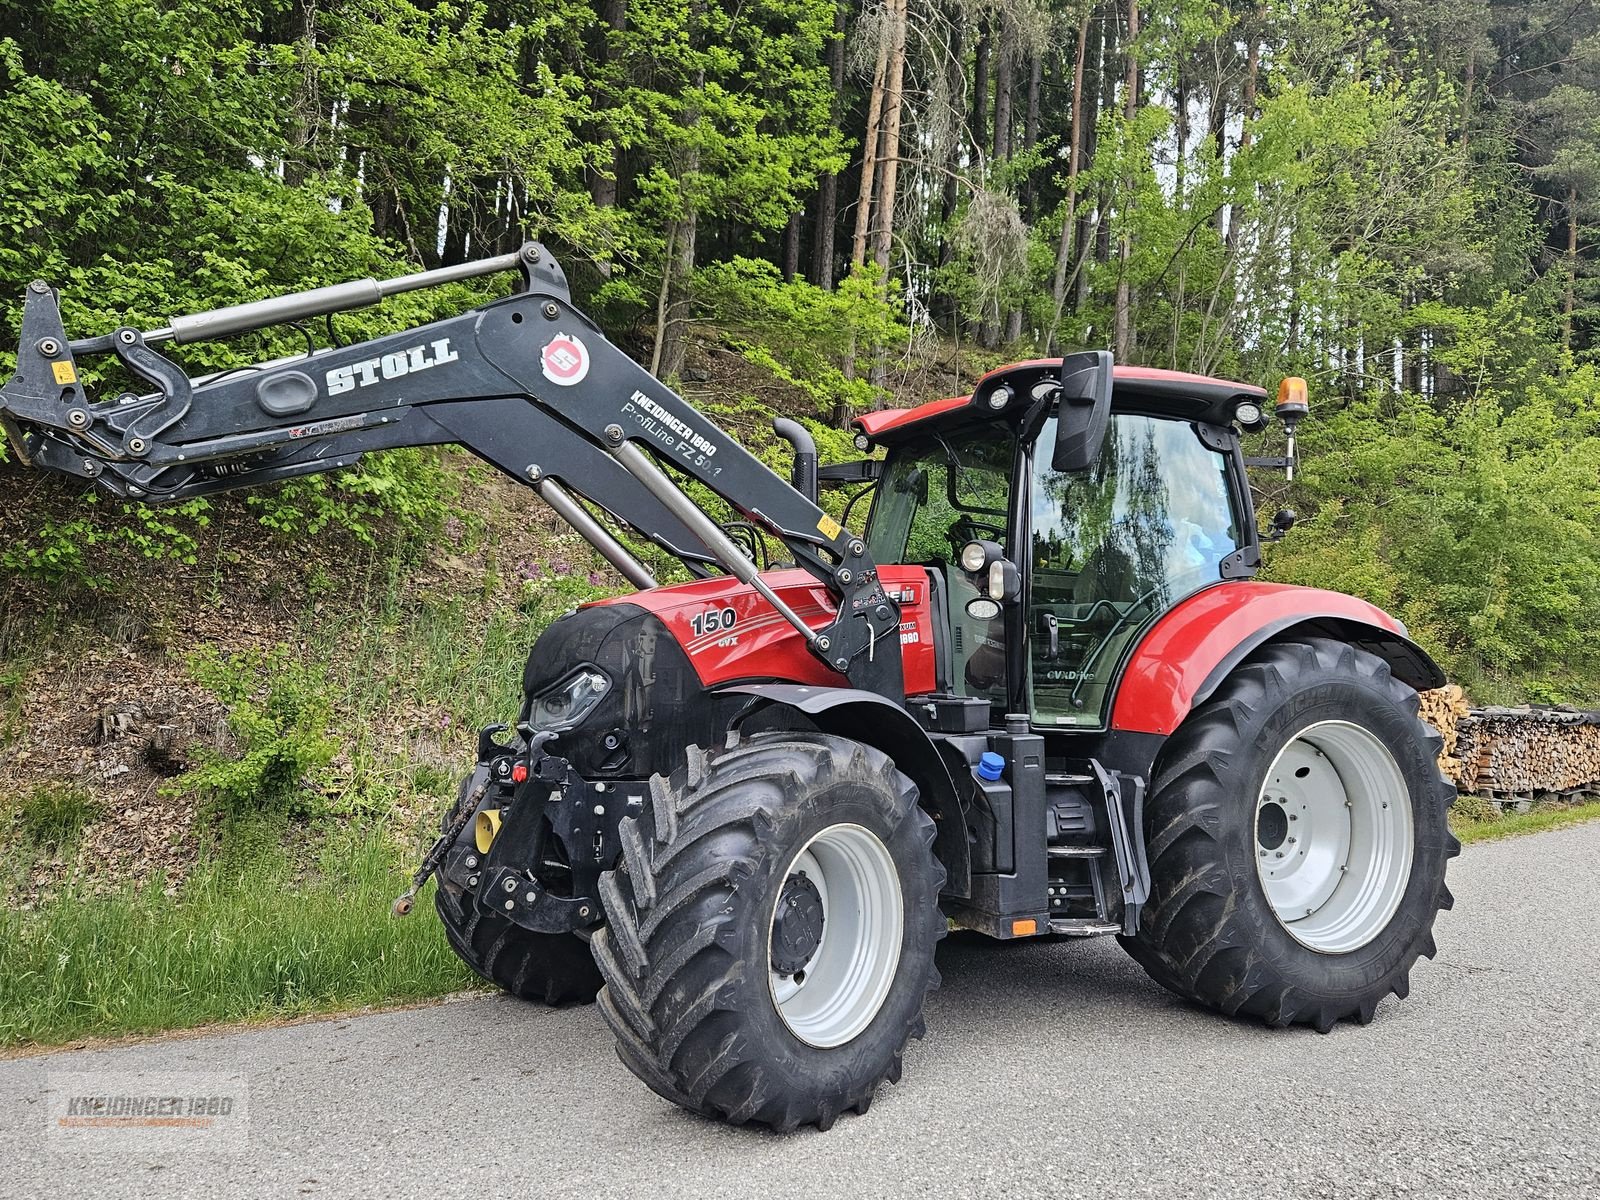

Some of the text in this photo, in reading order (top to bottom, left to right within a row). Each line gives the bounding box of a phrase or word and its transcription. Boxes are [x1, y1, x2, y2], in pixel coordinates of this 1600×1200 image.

[325, 338, 459, 397] STOLL
[630, 389, 718, 457] KNEIDINGER 1880
[674, 440, 697, 460] FZ
[690, 607, 738, 637] 150
[900, 622, 917, 631] XUM
[1046, 670, 1095, 681] CVXDrive
